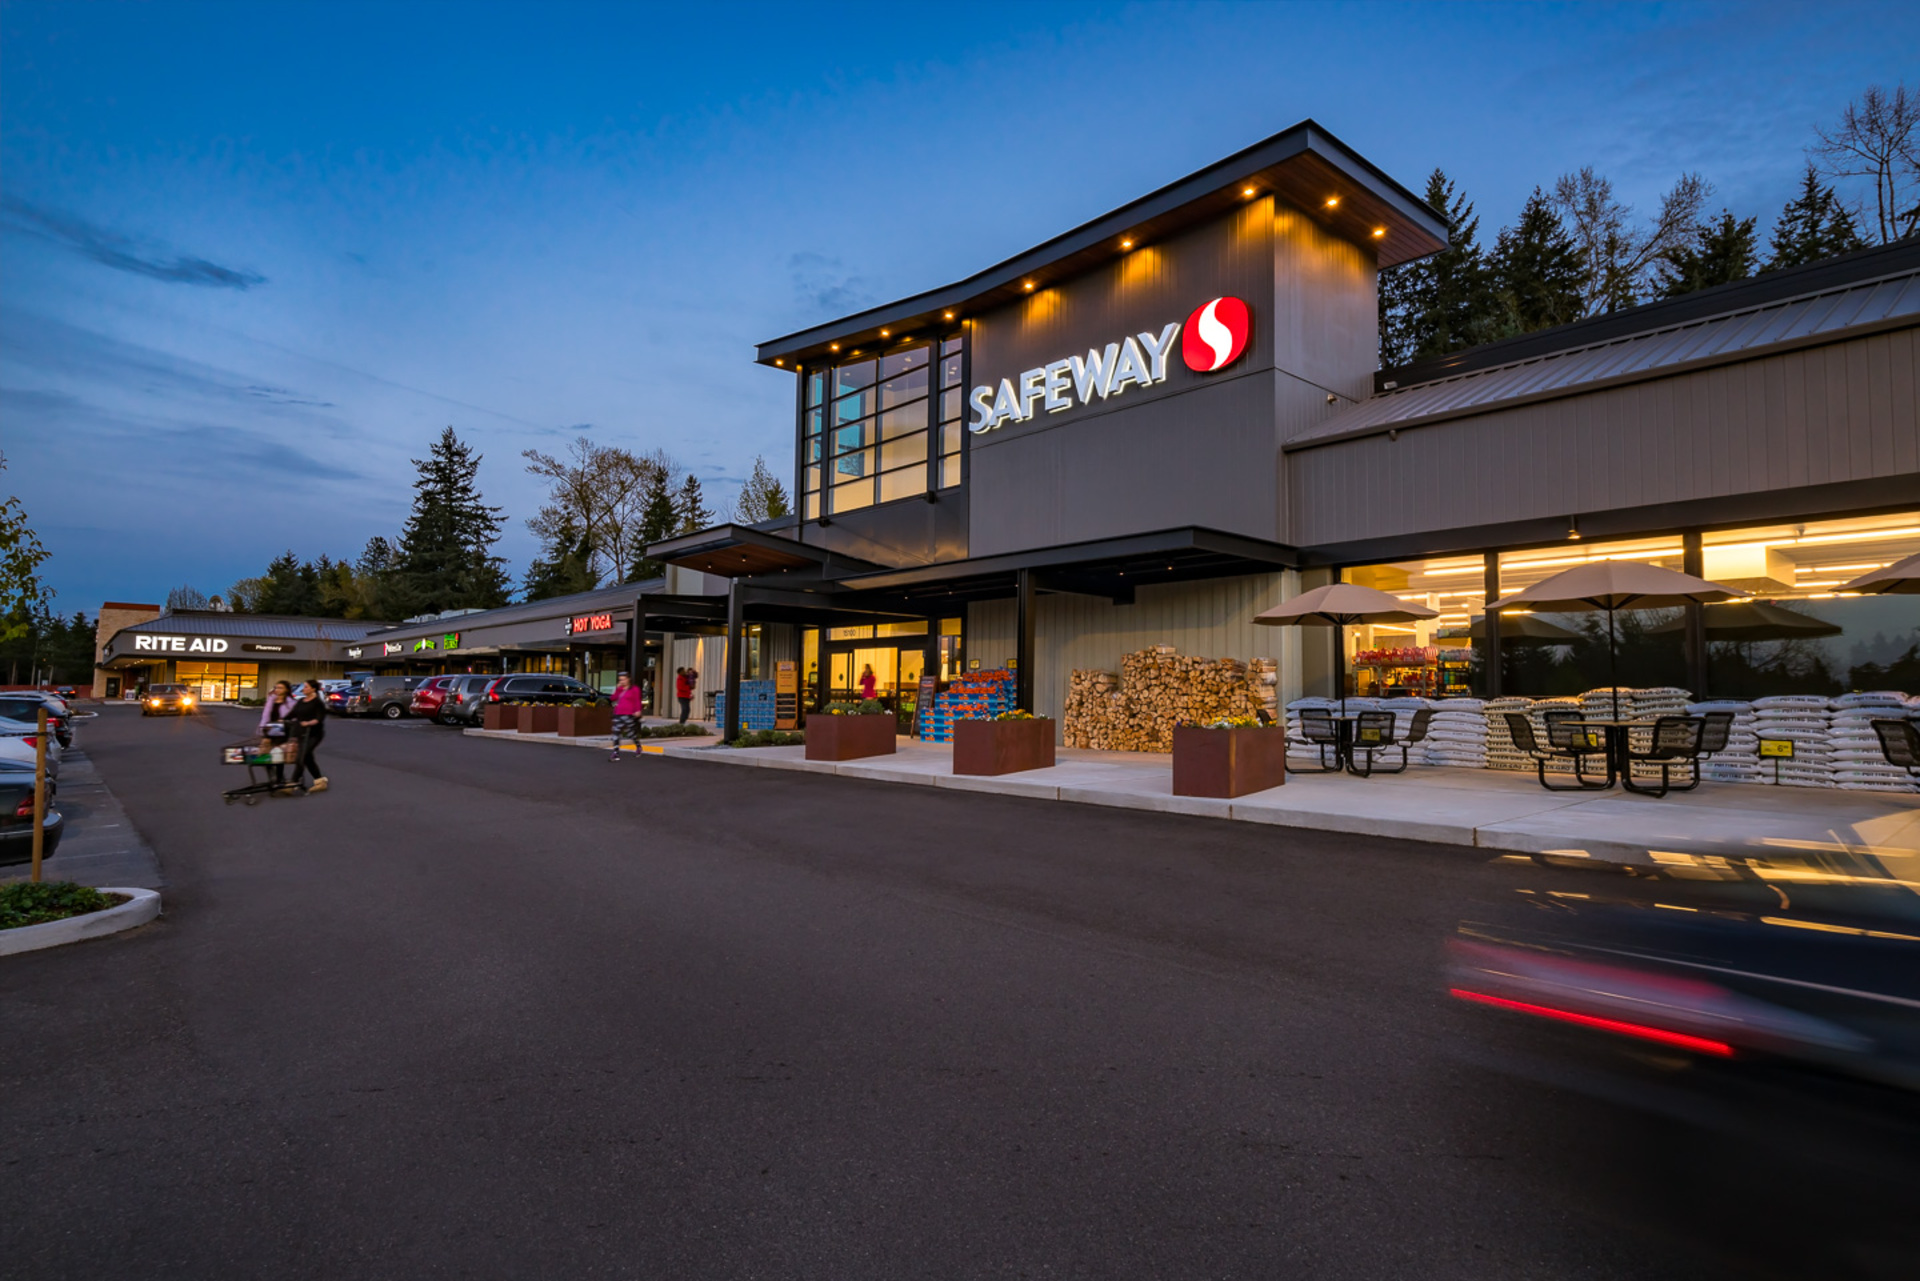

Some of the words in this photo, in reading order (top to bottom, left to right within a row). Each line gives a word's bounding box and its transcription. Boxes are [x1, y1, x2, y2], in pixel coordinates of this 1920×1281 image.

[968, 322, 1182, 434] SAFEWAY
[573, 617, 588, 632] HOT
[591, 614, 611, 630] YOGA
[135, 635, 186, 651] RITE
[188, 638, 229, 653] AID
[255, 644, 282, 652] Pharmacy
